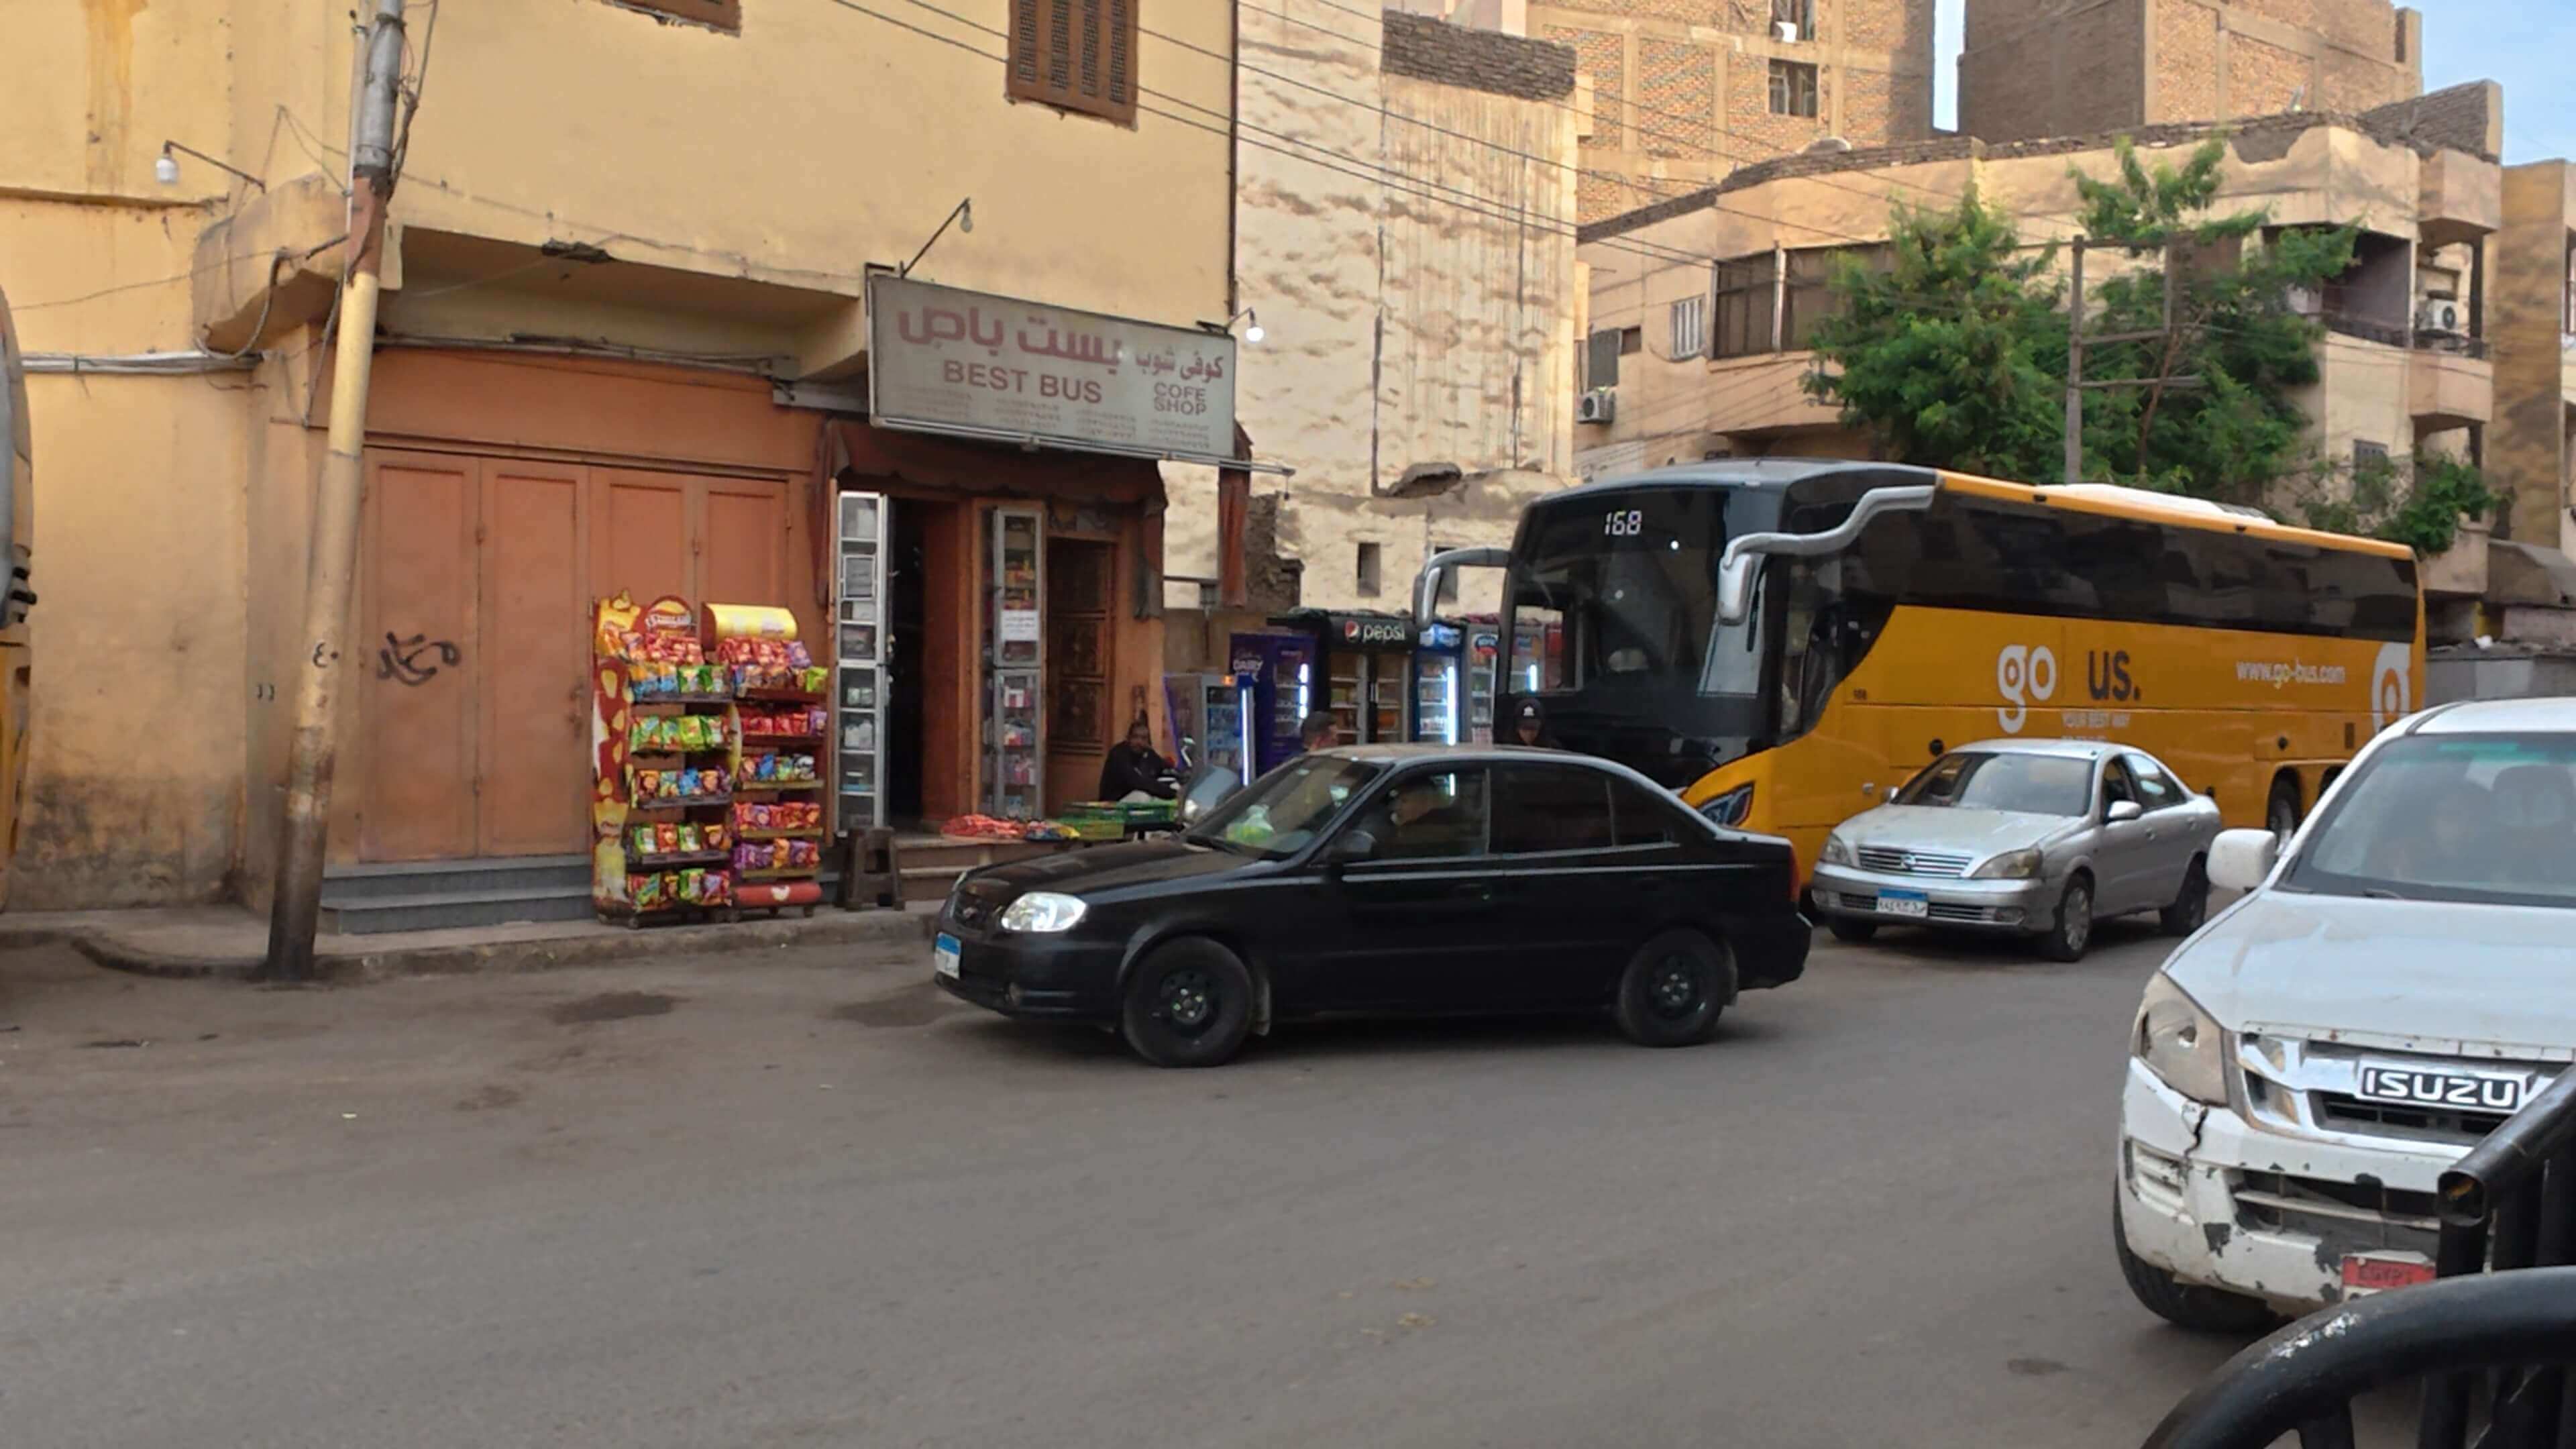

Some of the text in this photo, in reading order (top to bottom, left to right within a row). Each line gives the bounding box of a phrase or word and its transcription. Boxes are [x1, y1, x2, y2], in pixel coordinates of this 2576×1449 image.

[898, 305, 1122, 375] بست باص
[1135, 345, 1176, 376] شوب
[943, 359, 1103, 404] BEST BUS
[1154, 381, 1206, 402] COFE
[1154, 396, 1207, 416] SHOP
[1604, 510, 1642, 535] 168
[1362, 624, 1406, 645] pepsi
[1996, 643, 2057, 735] go
[2236, 657, 2346, 690] www.go-bus.com
[2365, 1069, 2515, 1108] ISUZU
